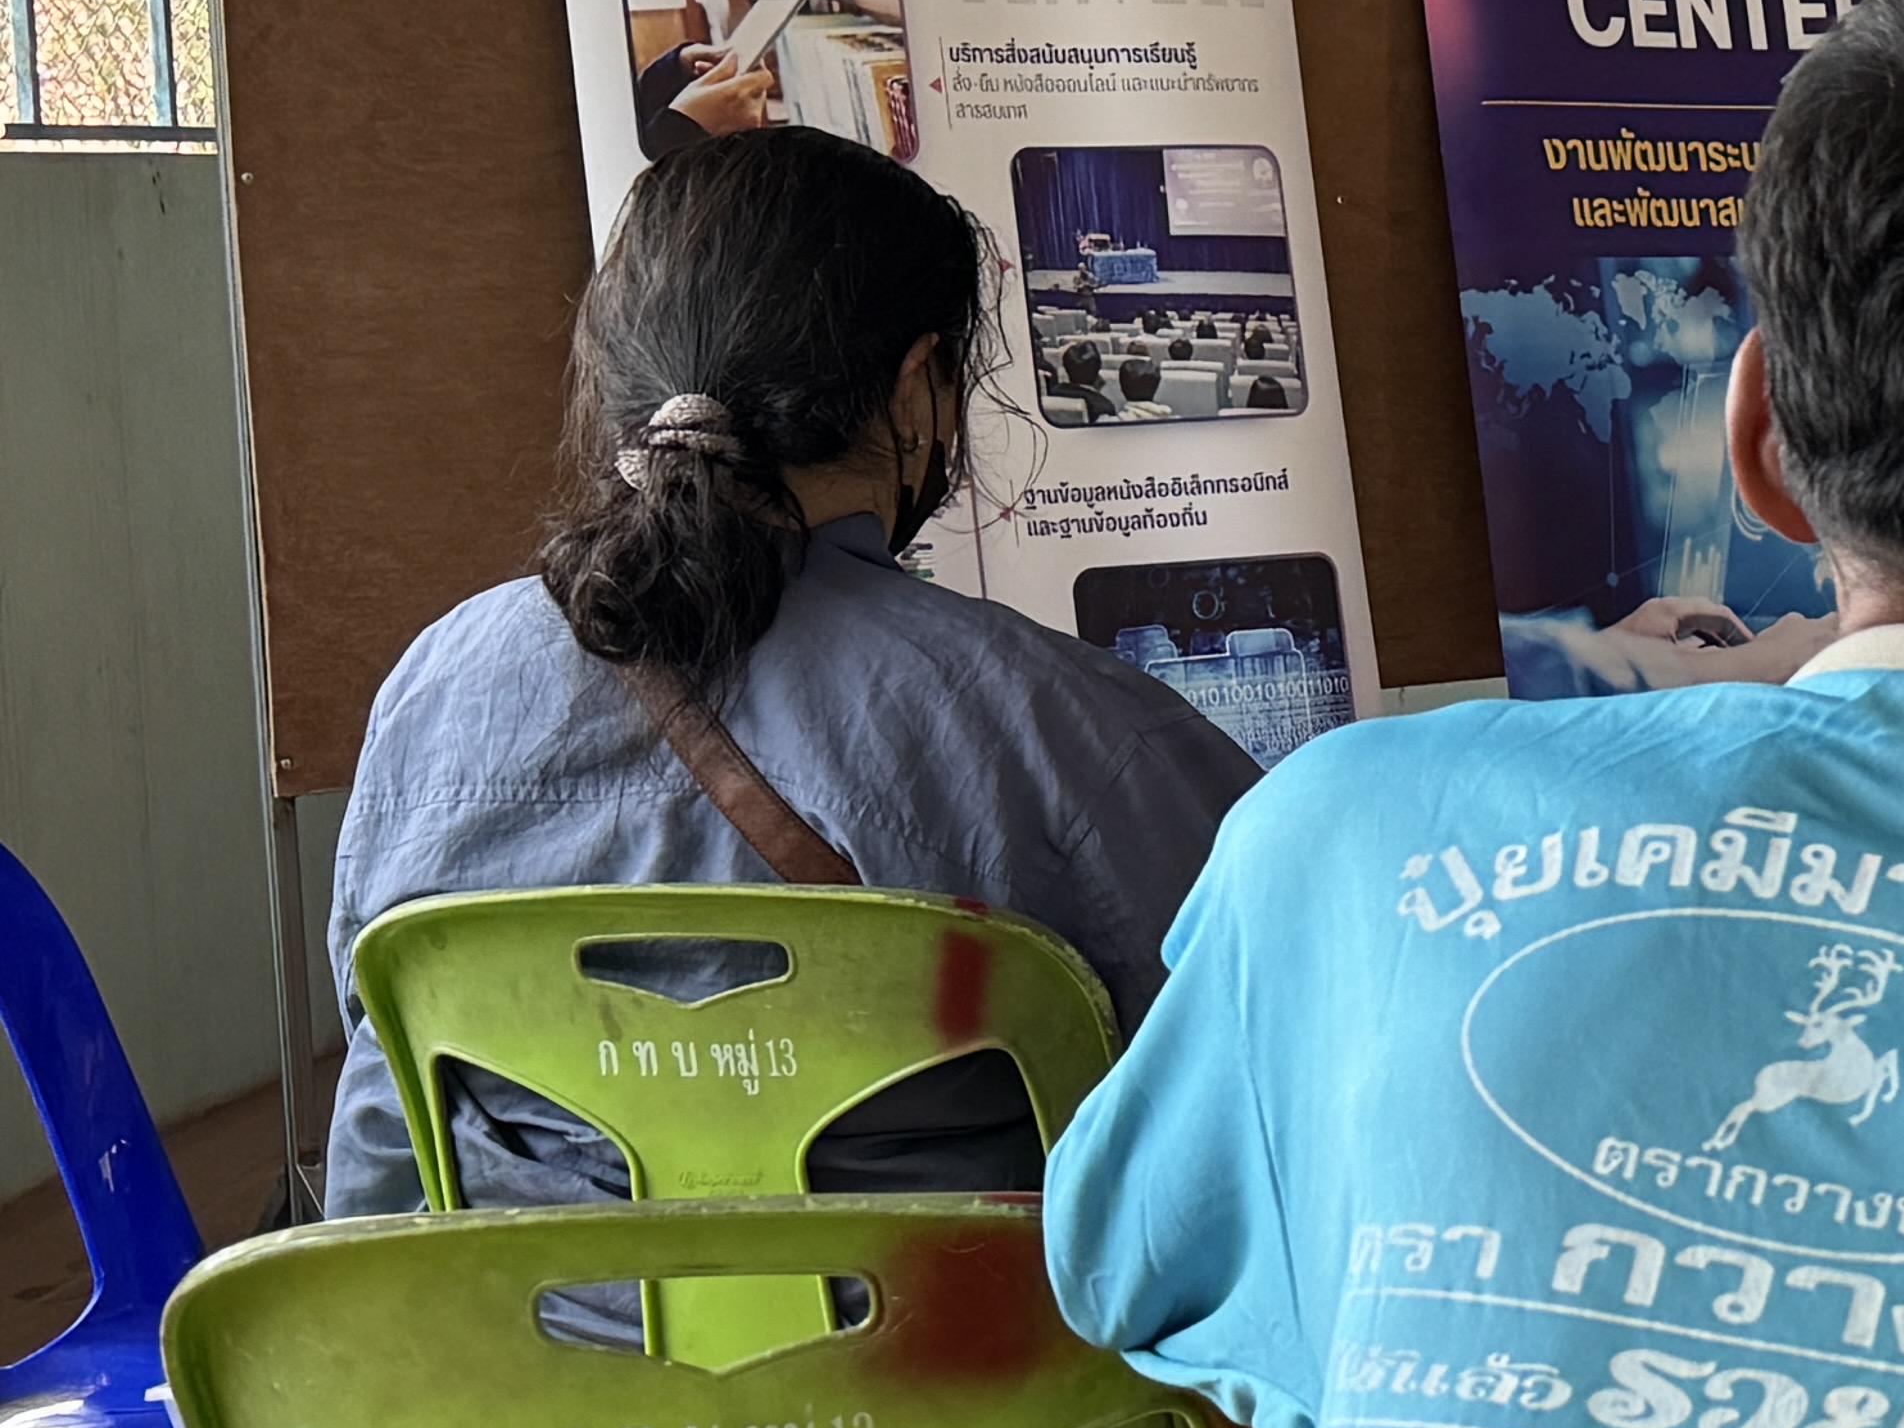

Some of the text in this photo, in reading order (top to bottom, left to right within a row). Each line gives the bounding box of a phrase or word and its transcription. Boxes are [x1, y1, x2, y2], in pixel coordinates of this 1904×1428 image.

[1543, 127, 1761, 172] งานพัฒนาระบ
[1573, 186, 1746, 229] และพัฒนาส
[1024, 468, 1288, 510] ฐานข้อมูลหนังสืออิเล็กทรอนิกส์
[1027, 502, 1208, 539] และฐานข้อมูลท้องถิ่น
